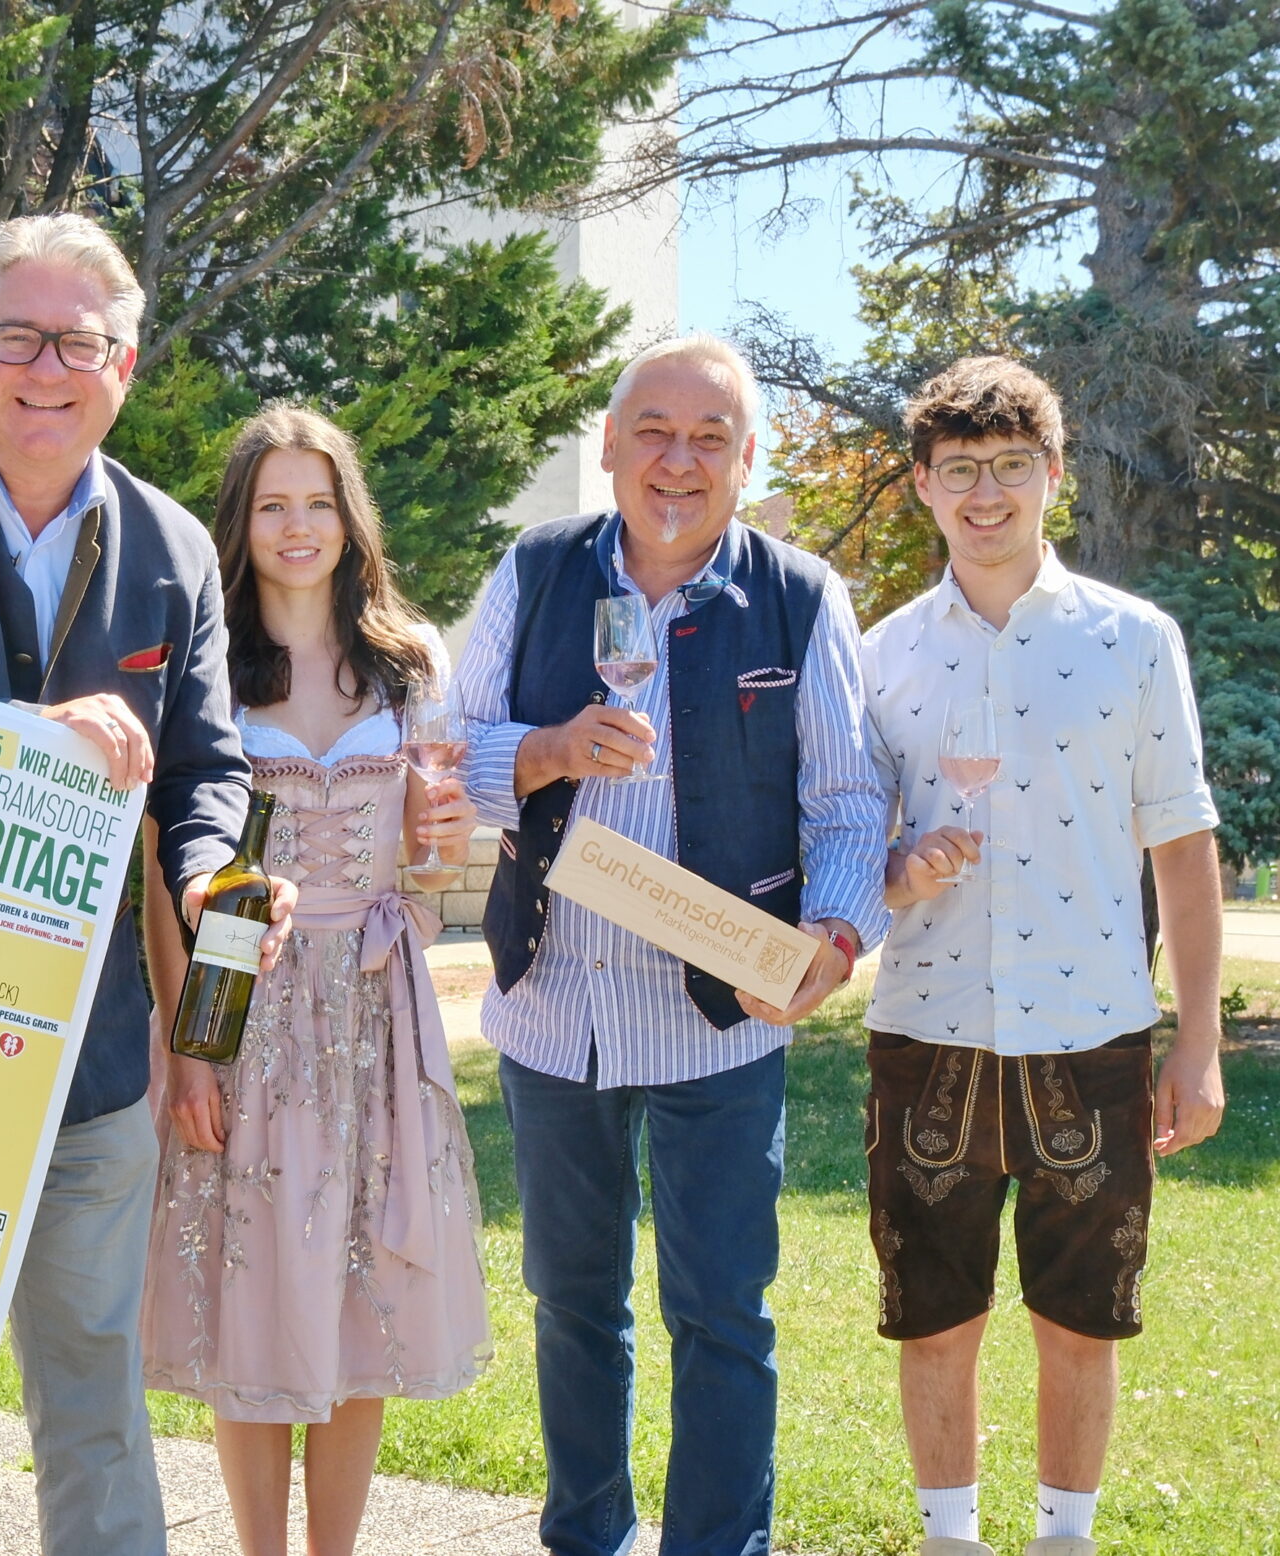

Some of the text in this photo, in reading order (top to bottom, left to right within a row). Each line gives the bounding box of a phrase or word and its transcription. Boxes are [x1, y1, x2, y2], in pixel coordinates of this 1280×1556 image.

[19, 745, 51, 778] WIR
[51, 758, 99, 797] LADEN
[580, 840, 763, 948] Guntramsdorf
[22, 910, 29, 919] &
[30, 912, 70, 931] OLDTIMER
[654, 909, 746, 965] Marktgemeinde
[70, 939, 85, 949] UHR
[31, 1018, 59, 1033] GRATIS
